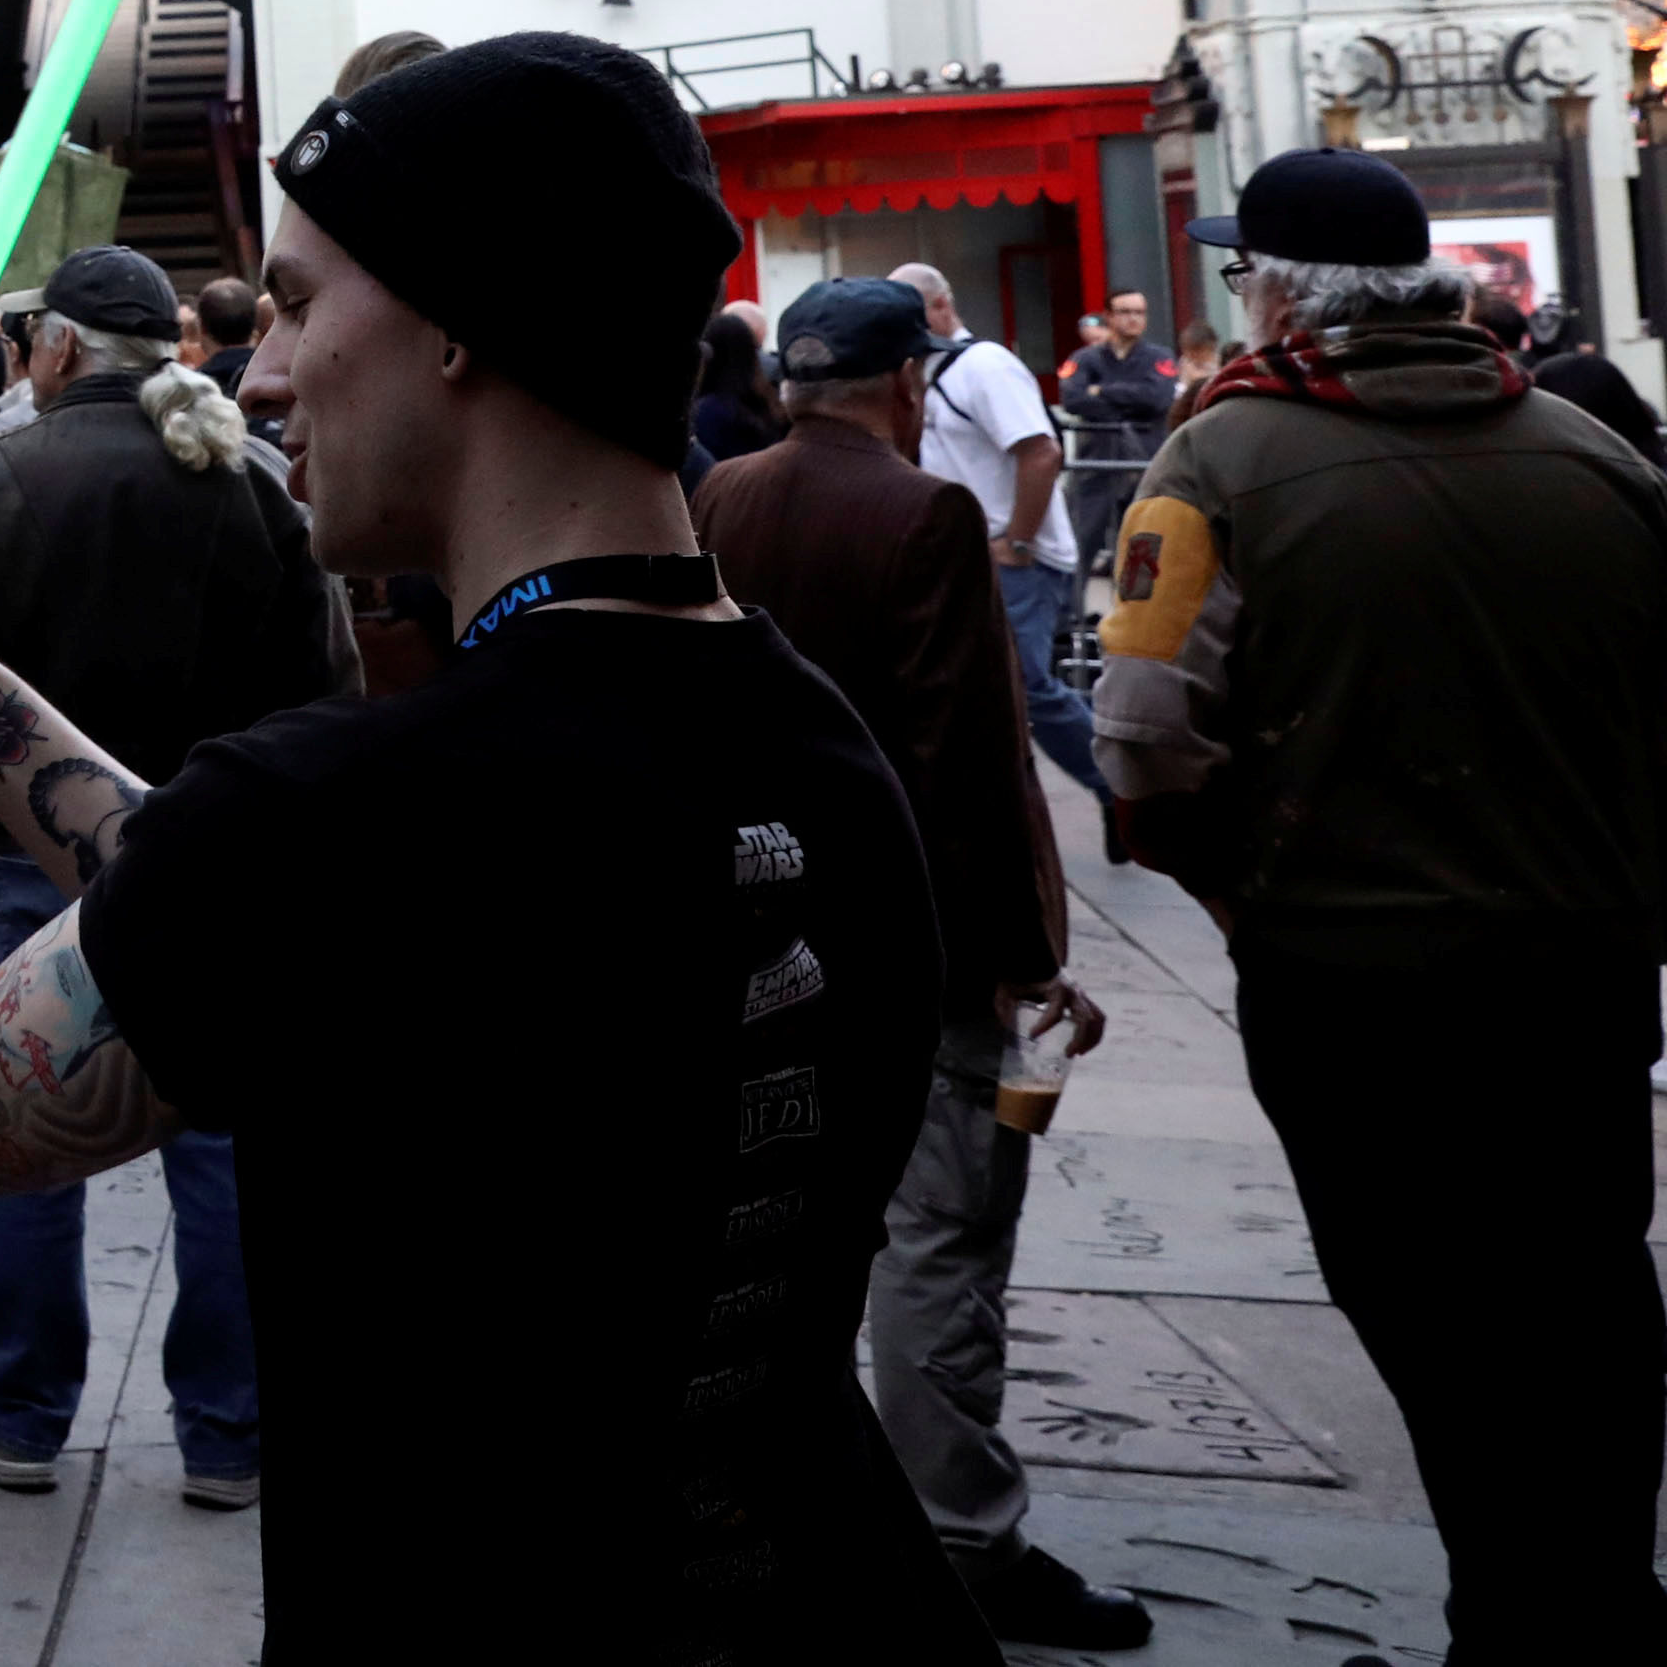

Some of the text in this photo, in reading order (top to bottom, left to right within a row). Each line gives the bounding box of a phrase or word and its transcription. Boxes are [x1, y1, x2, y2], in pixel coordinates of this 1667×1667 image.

[734, 821, 800, 855] STAR
[734, 847, 805, 886] WARS
[746, 945, 820, 1002] EMPIRE
